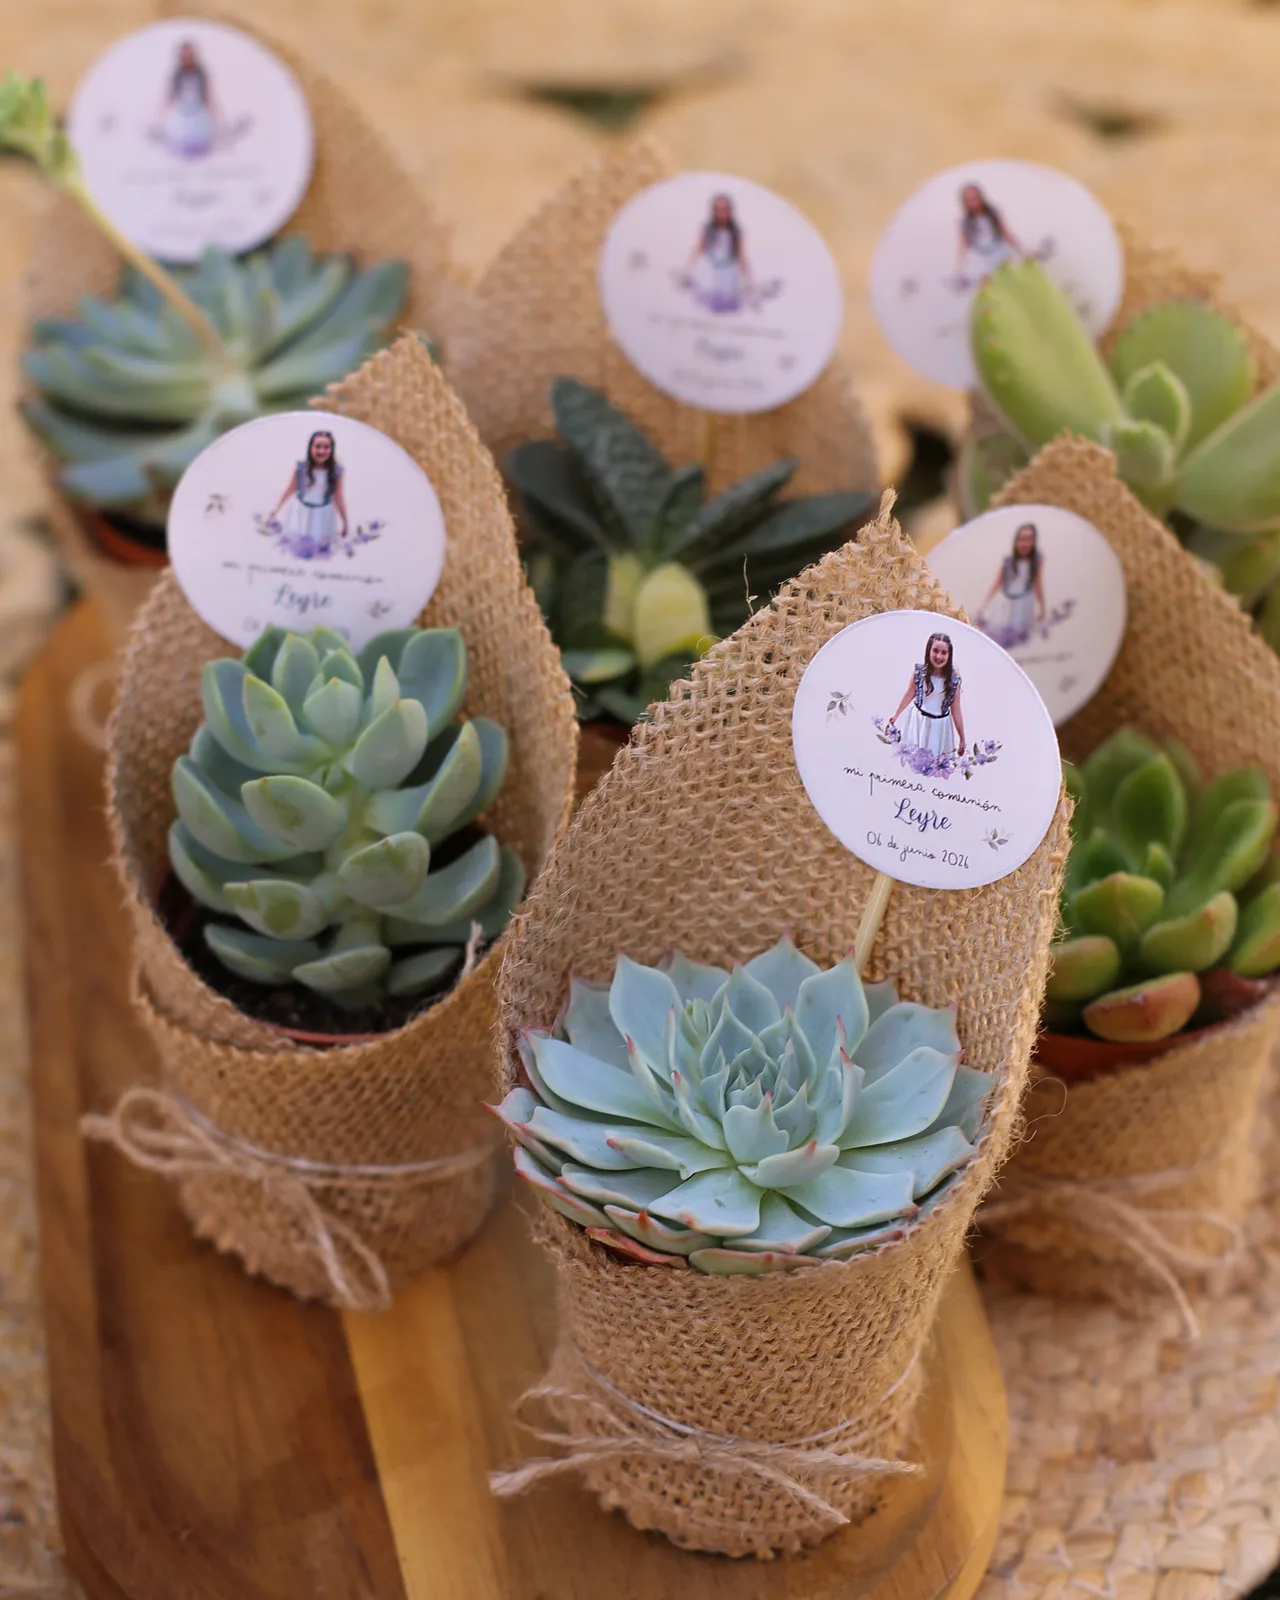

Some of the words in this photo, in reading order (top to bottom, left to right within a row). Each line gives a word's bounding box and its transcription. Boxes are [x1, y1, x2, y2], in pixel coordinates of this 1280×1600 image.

[843, 766, 864, 777] mi
[869, 772, 926, 797] primera
[931, 787, 1002, 812] comunión
[894, 798, 952, 832] Leyre
[866, 831, 882, 847] 06
[887, 835, 899, 850] de
[900, 845, 936, 863] junio
[941, 849, 969, 869] 2026
